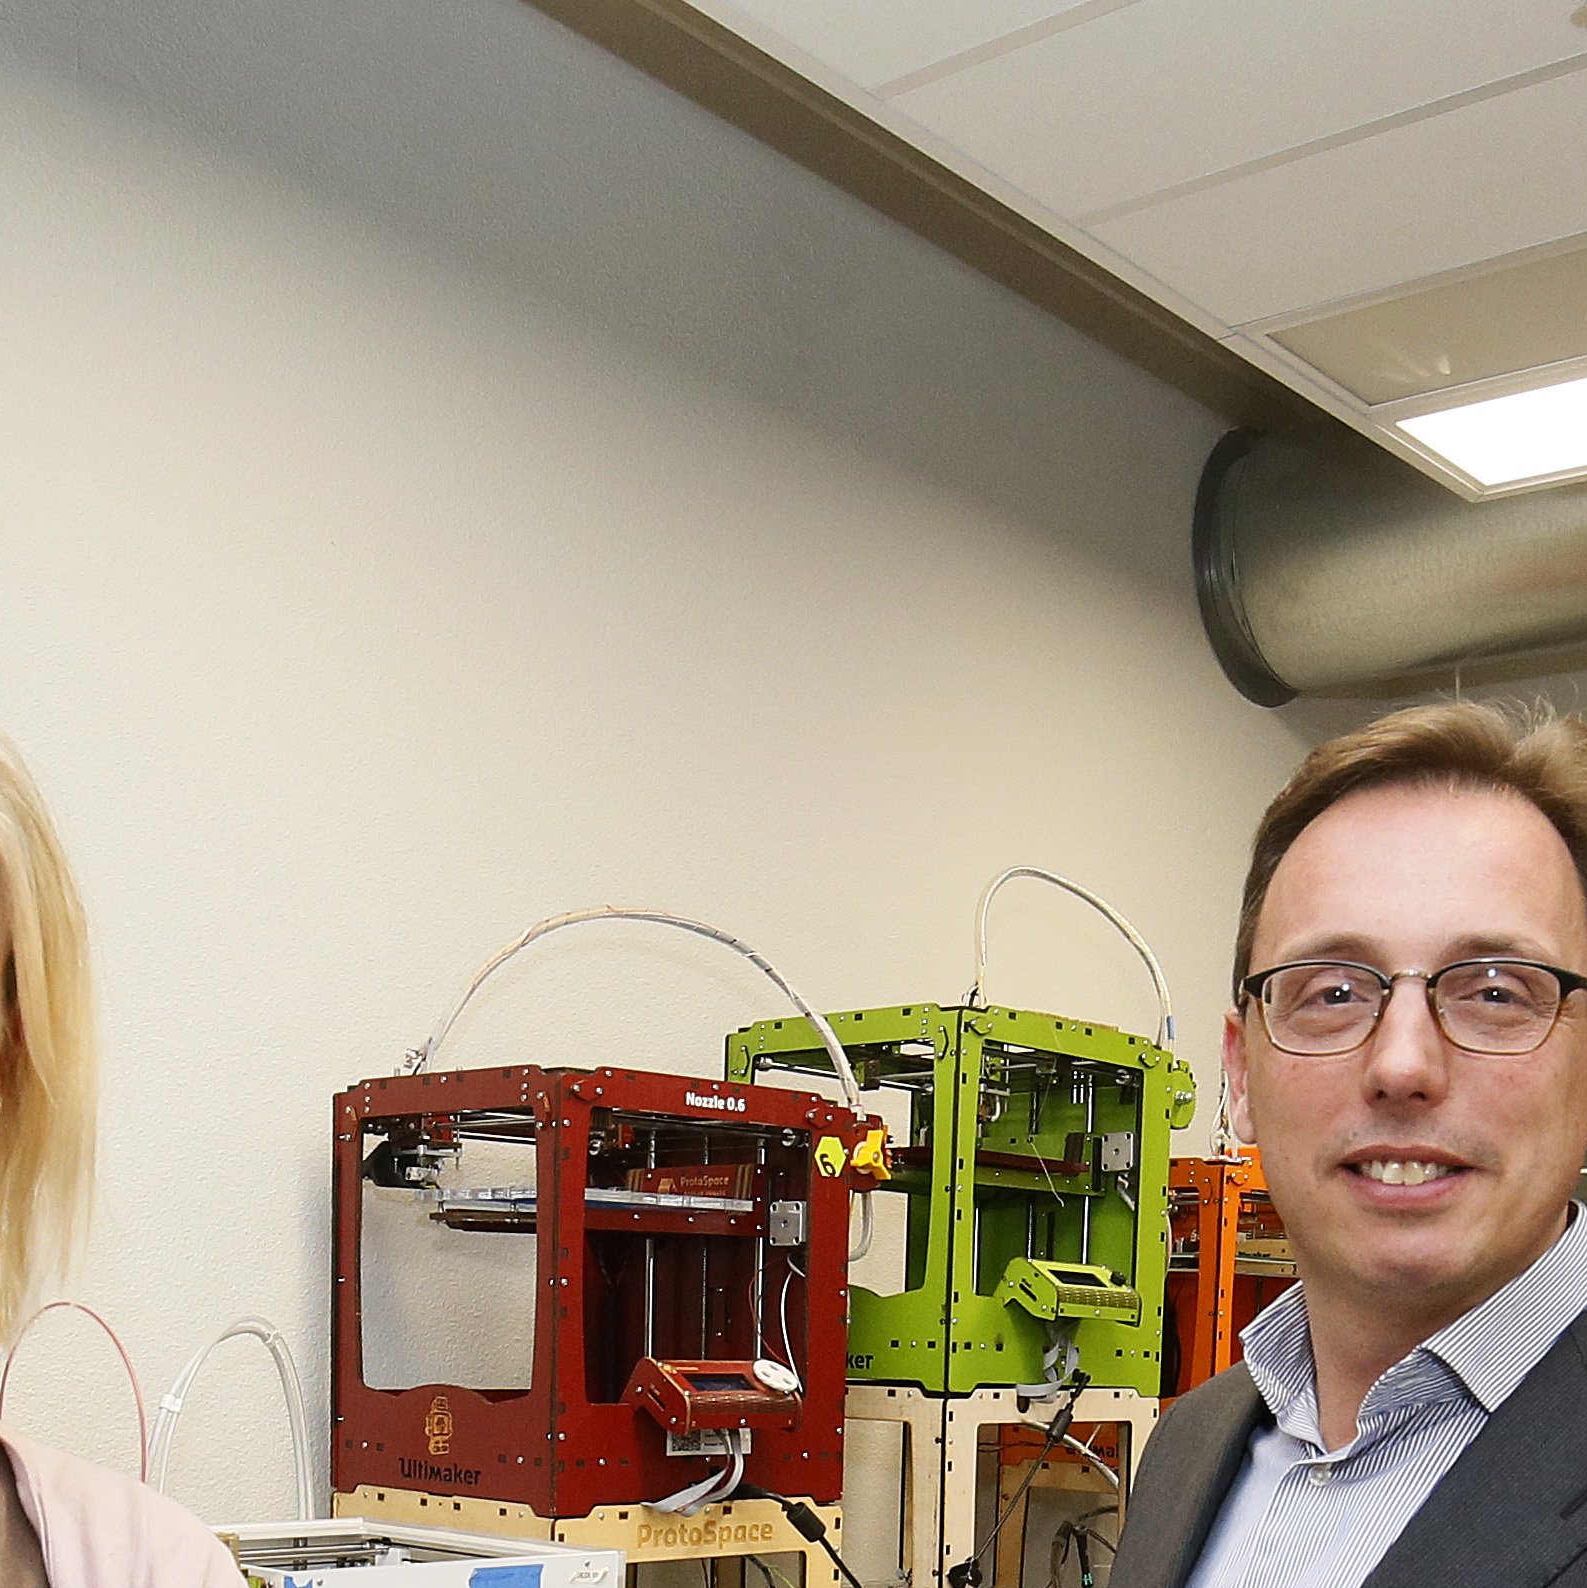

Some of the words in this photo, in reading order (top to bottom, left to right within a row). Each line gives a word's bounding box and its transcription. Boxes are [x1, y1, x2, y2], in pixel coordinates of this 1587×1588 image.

[685, 1091, 725, 1110] Nozzle
[727, 1096, 746, 1112] 0.6
[680, 1174, 730, 1188] ProtoSpace
[398, 1457, 482, 1486] Ultimaker
[637, 1520, 774, 1549] ProtoSpace
